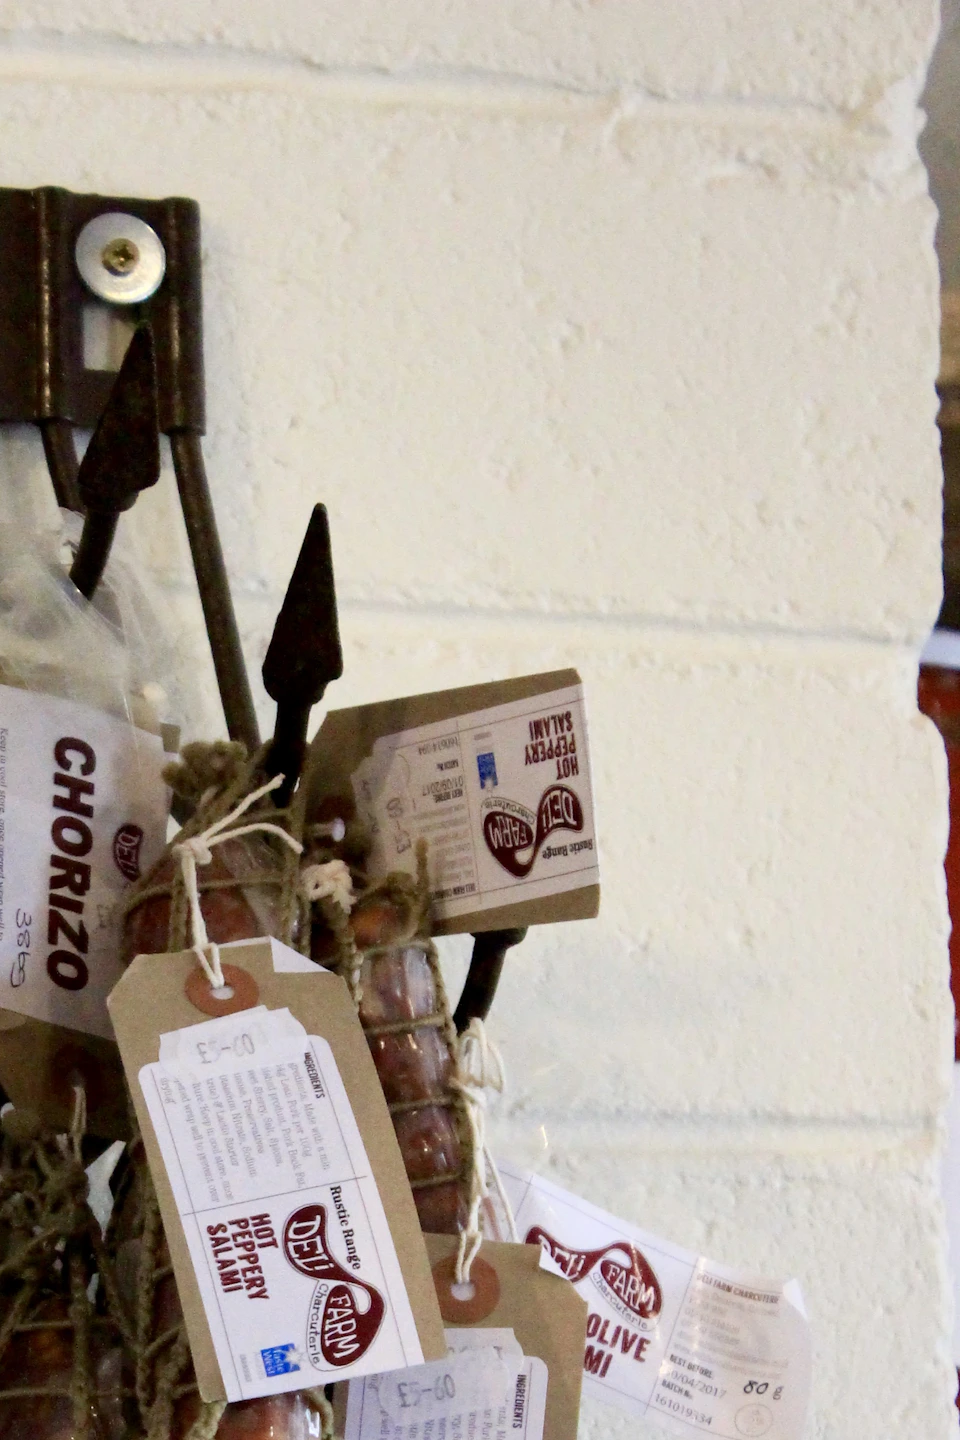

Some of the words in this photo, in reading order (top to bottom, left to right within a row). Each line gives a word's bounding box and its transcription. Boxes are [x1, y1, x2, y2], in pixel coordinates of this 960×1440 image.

[525, 734, 576, 764] PEPPERY
[529, 711, 573, 739] SALAMI
[553, 755, 579, 779] HOT
[490, 814, 527, 851] FARM
[542, 846, 567, 860] Range
[46, 736, 96, 991] CHORIZO
[302, 1051, 324, 1099] INGREDIENTS
[249, 1212, 278, 1253] HOT
[330, 1186, 348, 1227] Rustic
[343, 1228, 361, 1270] Range
[205, 1221, 243, 1294] SALAMI
[227, 1216, 269, 1303] PEPPERY
[592, 1271, 648, 1329] Charcuterie
[607, 1265, 655, 1310] FARM
[308, 1283, 329, 1364] Charcuterie
[324, 1293, 360, 1360] FARM
[586, 1313, 650, 1362] OLIVE
[261, 1349, 276, 1374] West
[666, 1367, 727, 1399] 0/04/2017
[512, 1374, 526, 1429] INGREDIENTS
